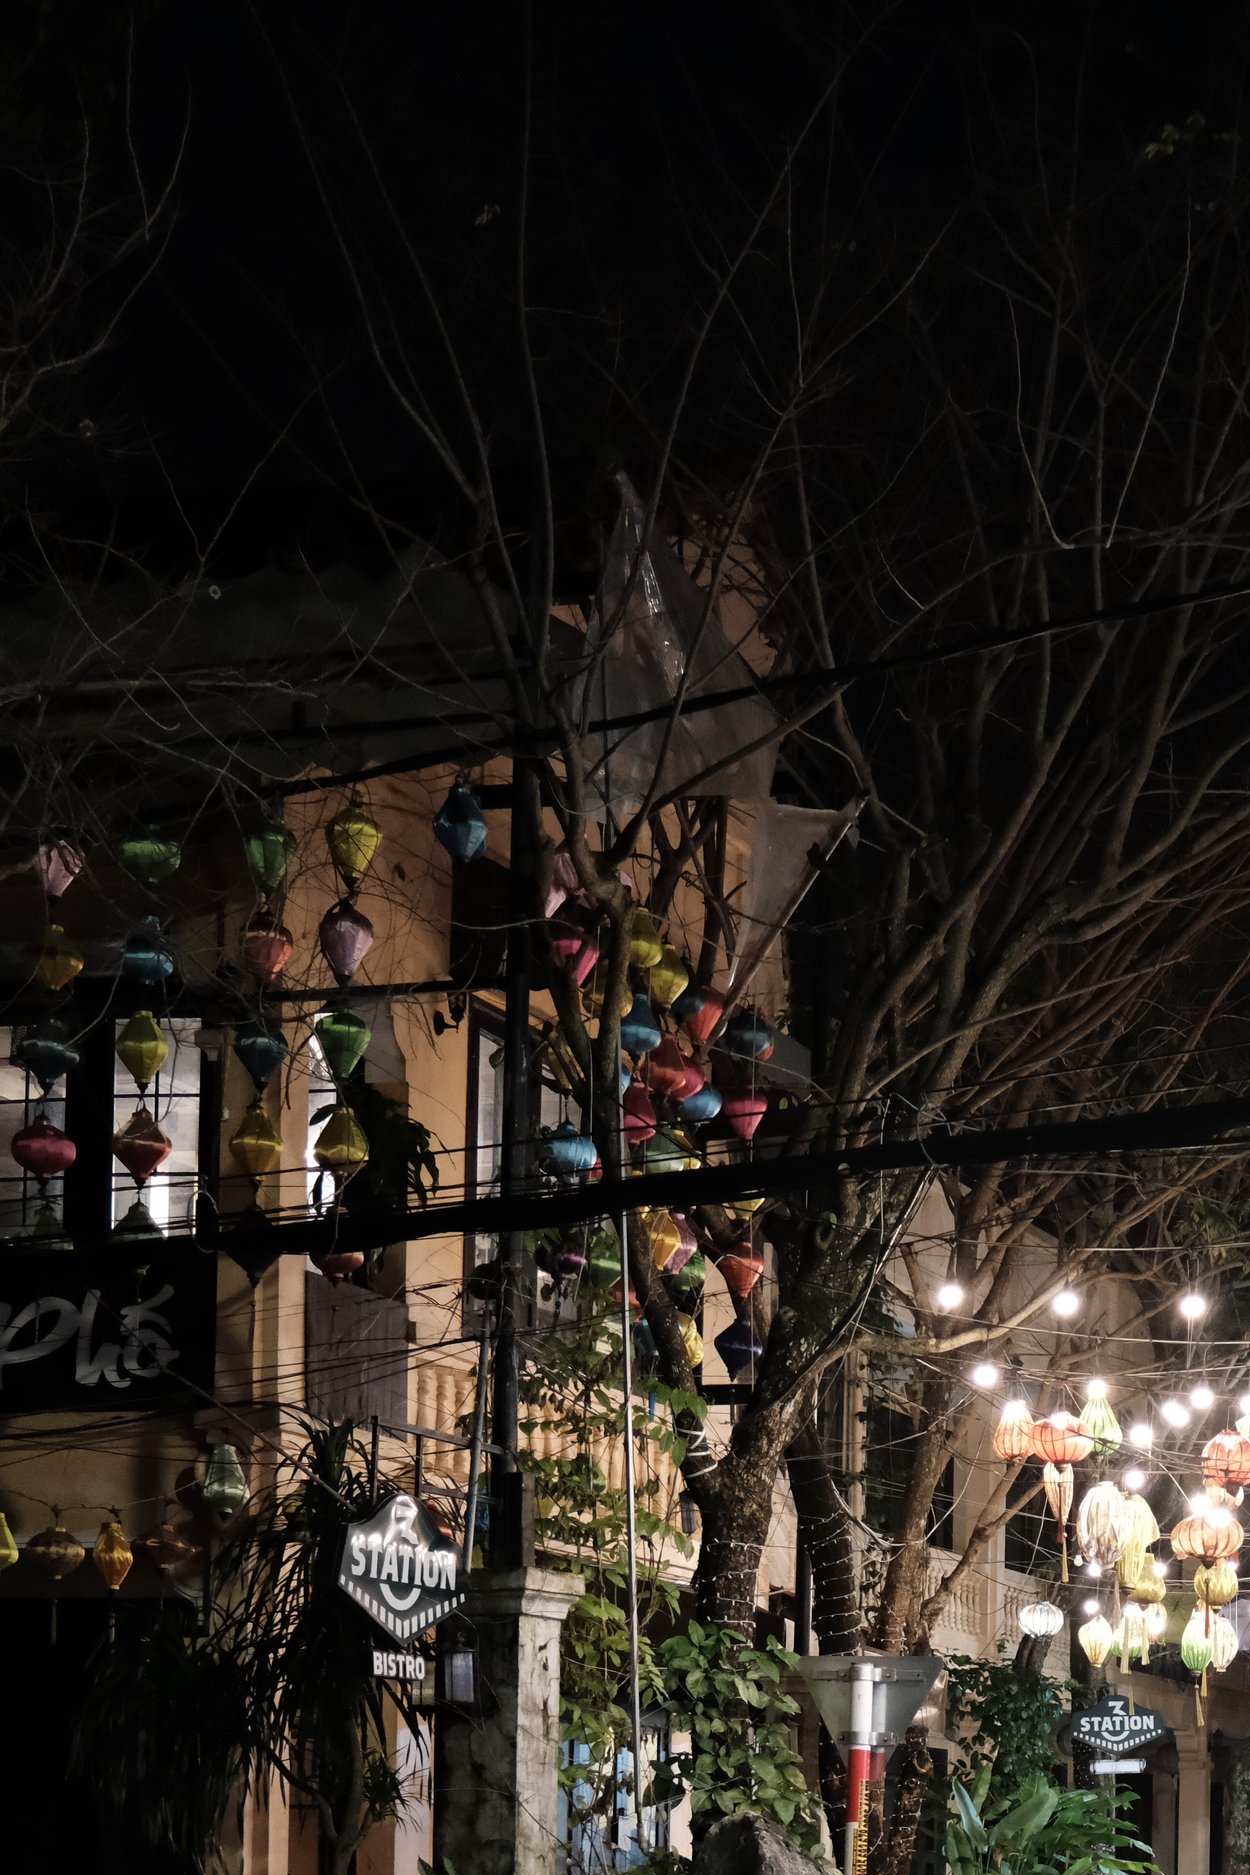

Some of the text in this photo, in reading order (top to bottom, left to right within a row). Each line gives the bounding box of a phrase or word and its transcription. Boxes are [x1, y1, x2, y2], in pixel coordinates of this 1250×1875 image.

[351, 1534, 457, 1591] STATION
[373, 1651, 426, 1681] BISTRO
[1080, 1715, 1155, 1732] STATION
